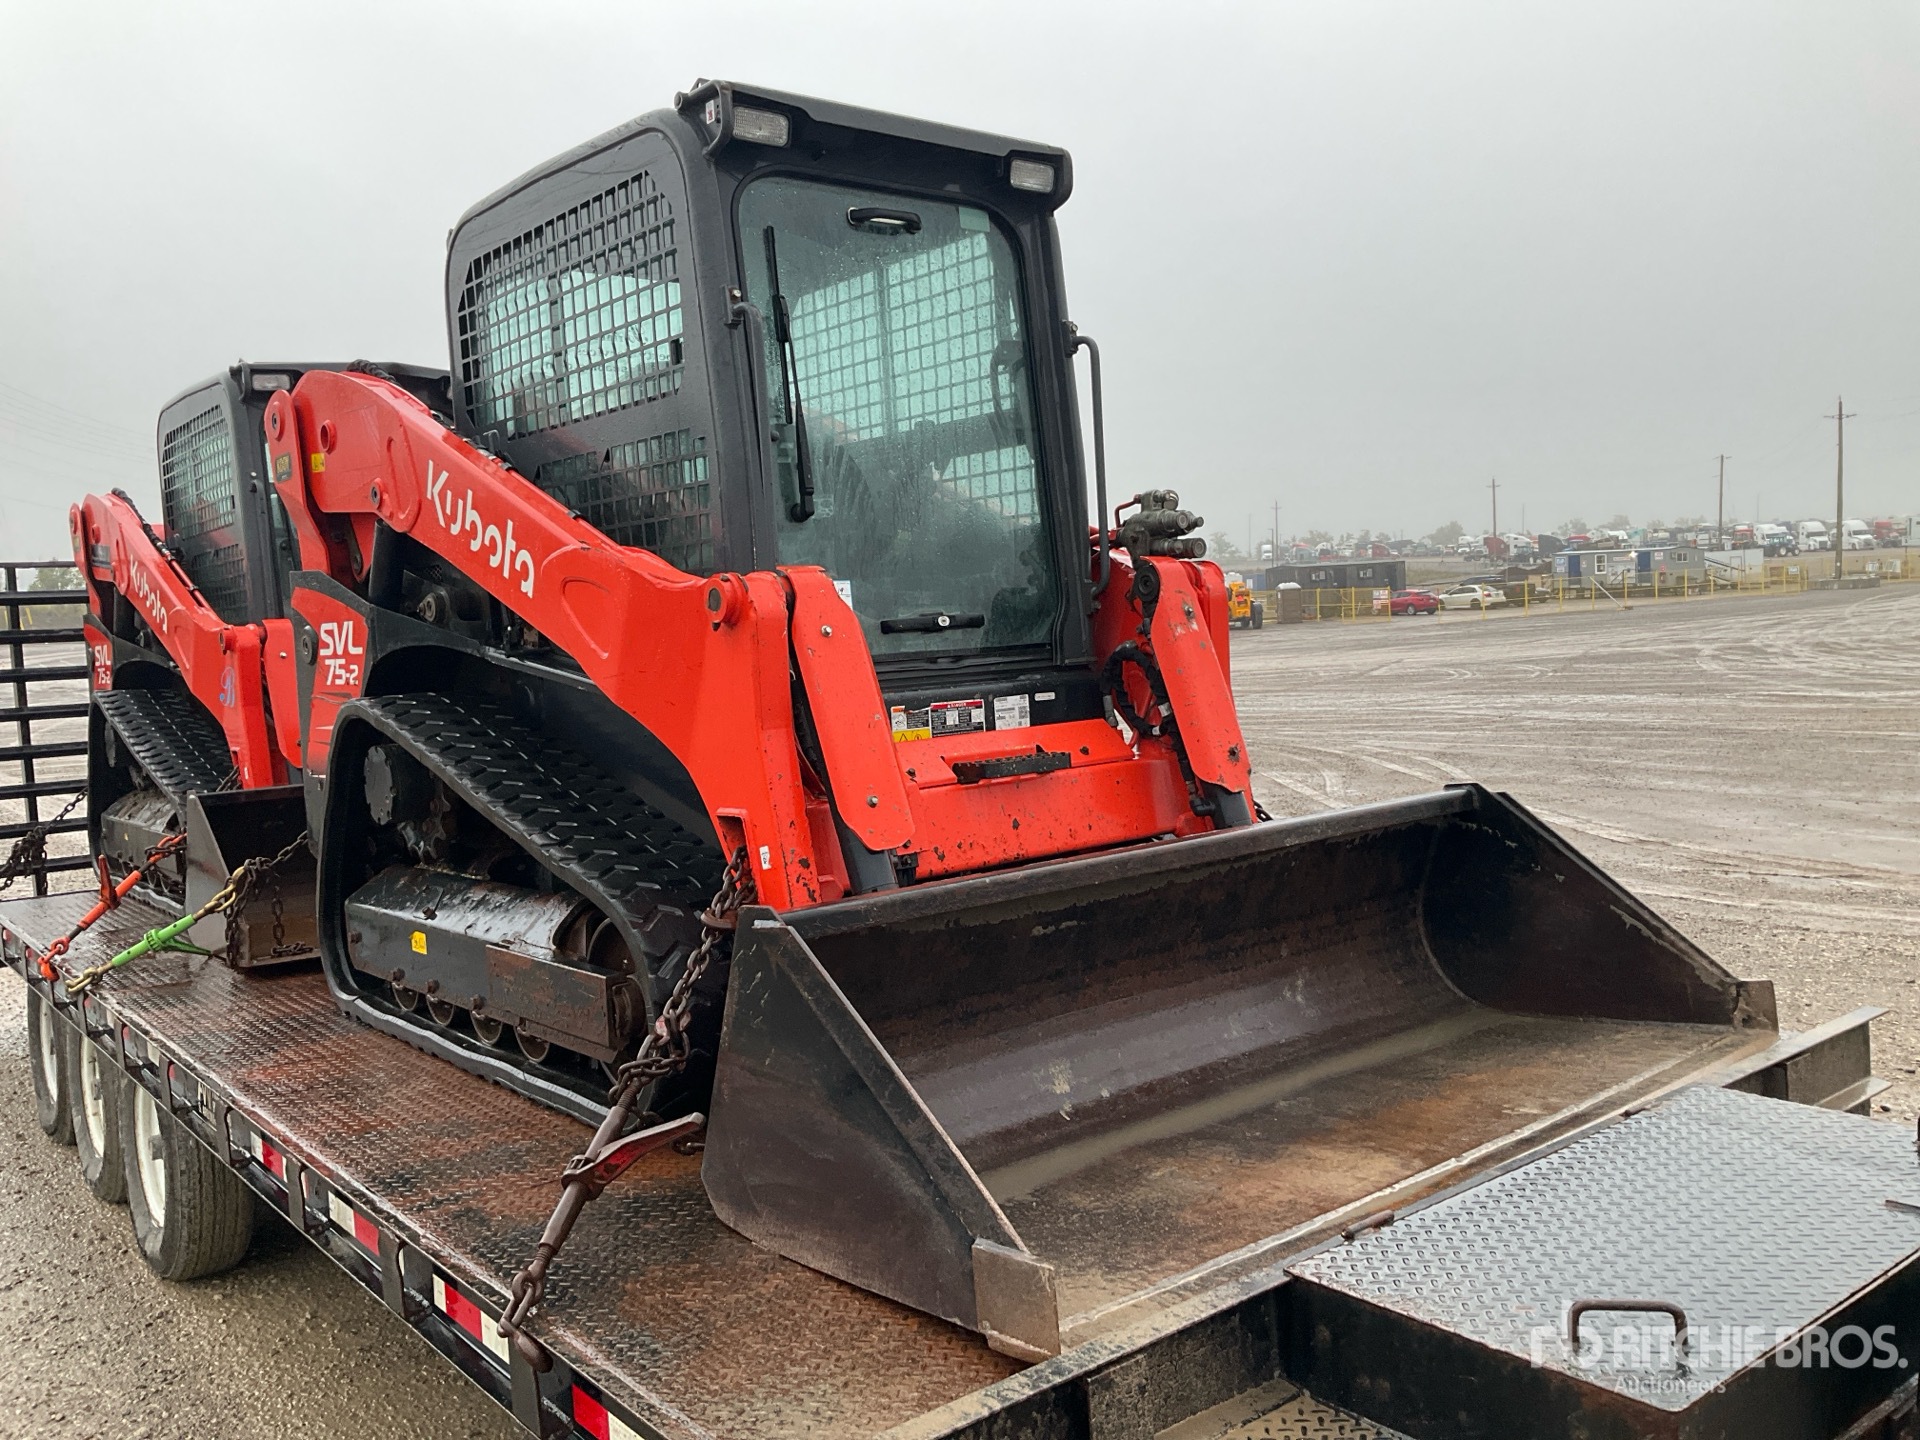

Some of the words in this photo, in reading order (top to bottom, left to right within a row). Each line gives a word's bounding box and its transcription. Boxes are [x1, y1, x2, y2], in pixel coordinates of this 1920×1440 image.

[426, 459, 535, 599] Kubota
[130, 554, 168, 634] Kubota
[94, 645, 111, 666] SVL
[320, 620, 363, 656] SVL
[324, 658, 359, 686] 75-2
